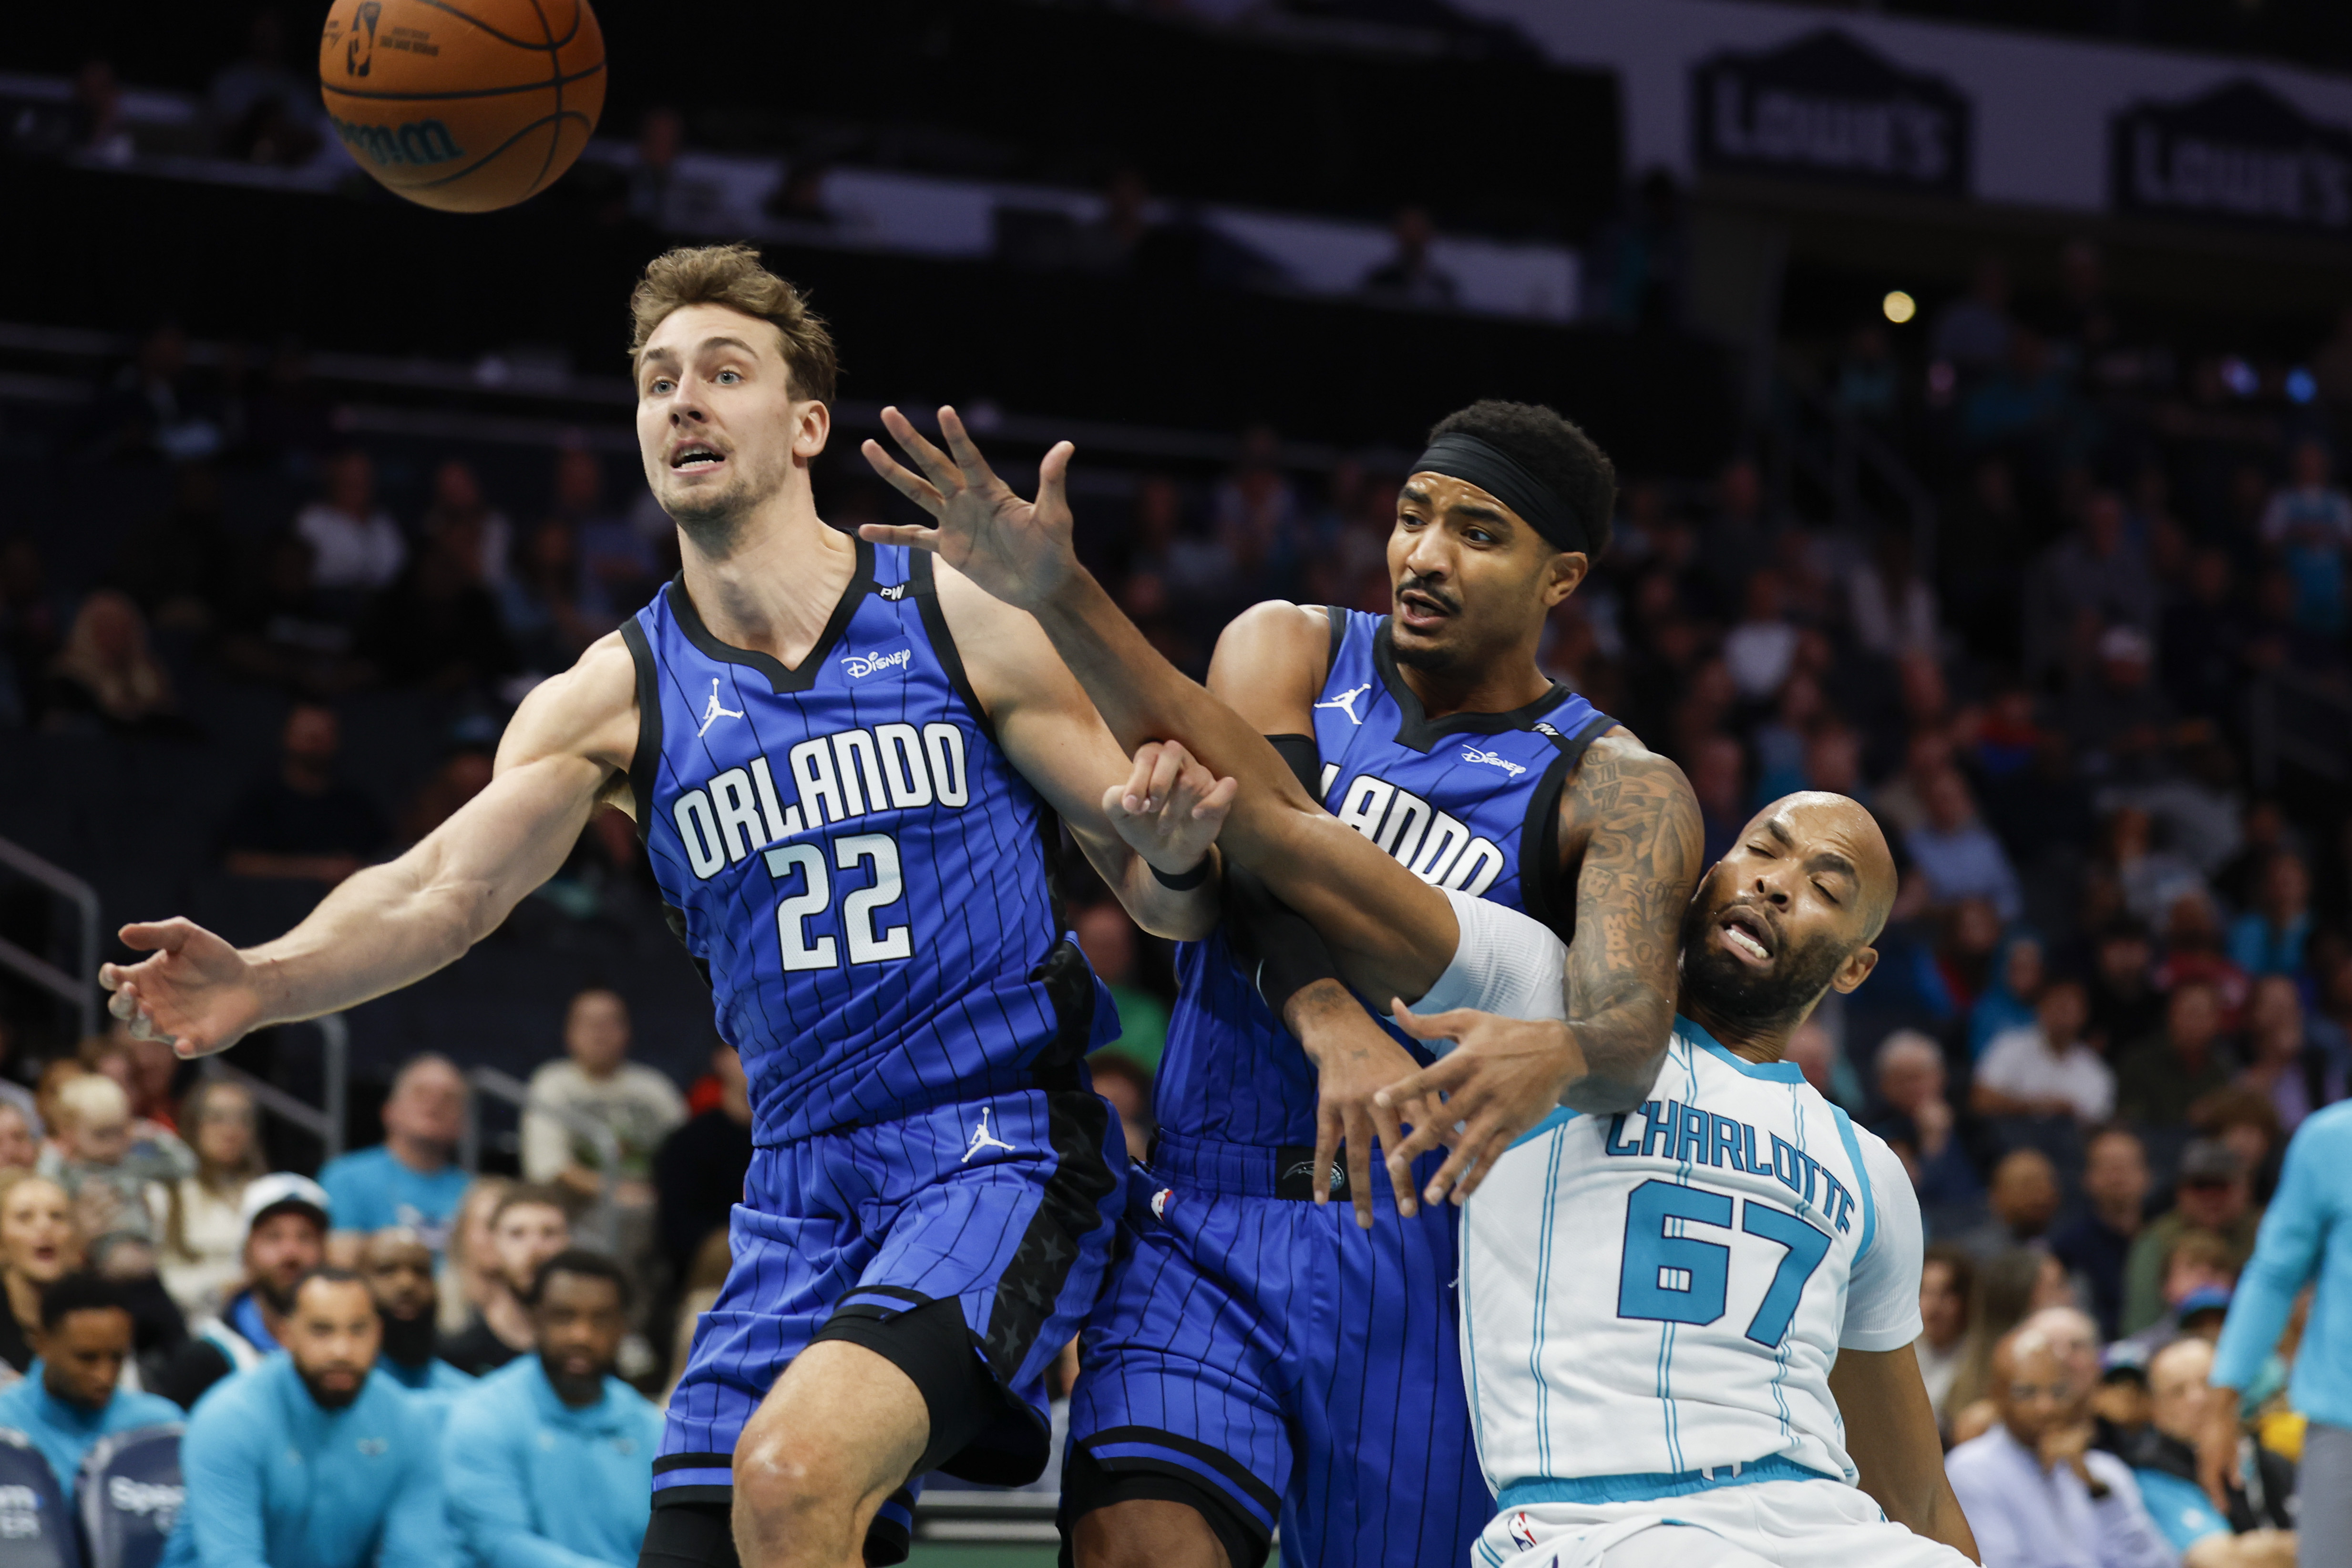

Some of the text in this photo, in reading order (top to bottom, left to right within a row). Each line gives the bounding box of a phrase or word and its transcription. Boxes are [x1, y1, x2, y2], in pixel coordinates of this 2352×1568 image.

[880, 584, 904, 600] PW
[841, 649, 911, 678] Disney
[673, 722, 969, 880] ORLANDO
[1461, 744, 1527, 778] Disney
[1320, 762, 1504, 898] ANDO
[763, 832, 912, 971] 22
[1605, 1099, 1855, 1235] CHARLOTTE
[1617, 1179, 1832, 1349] 67
